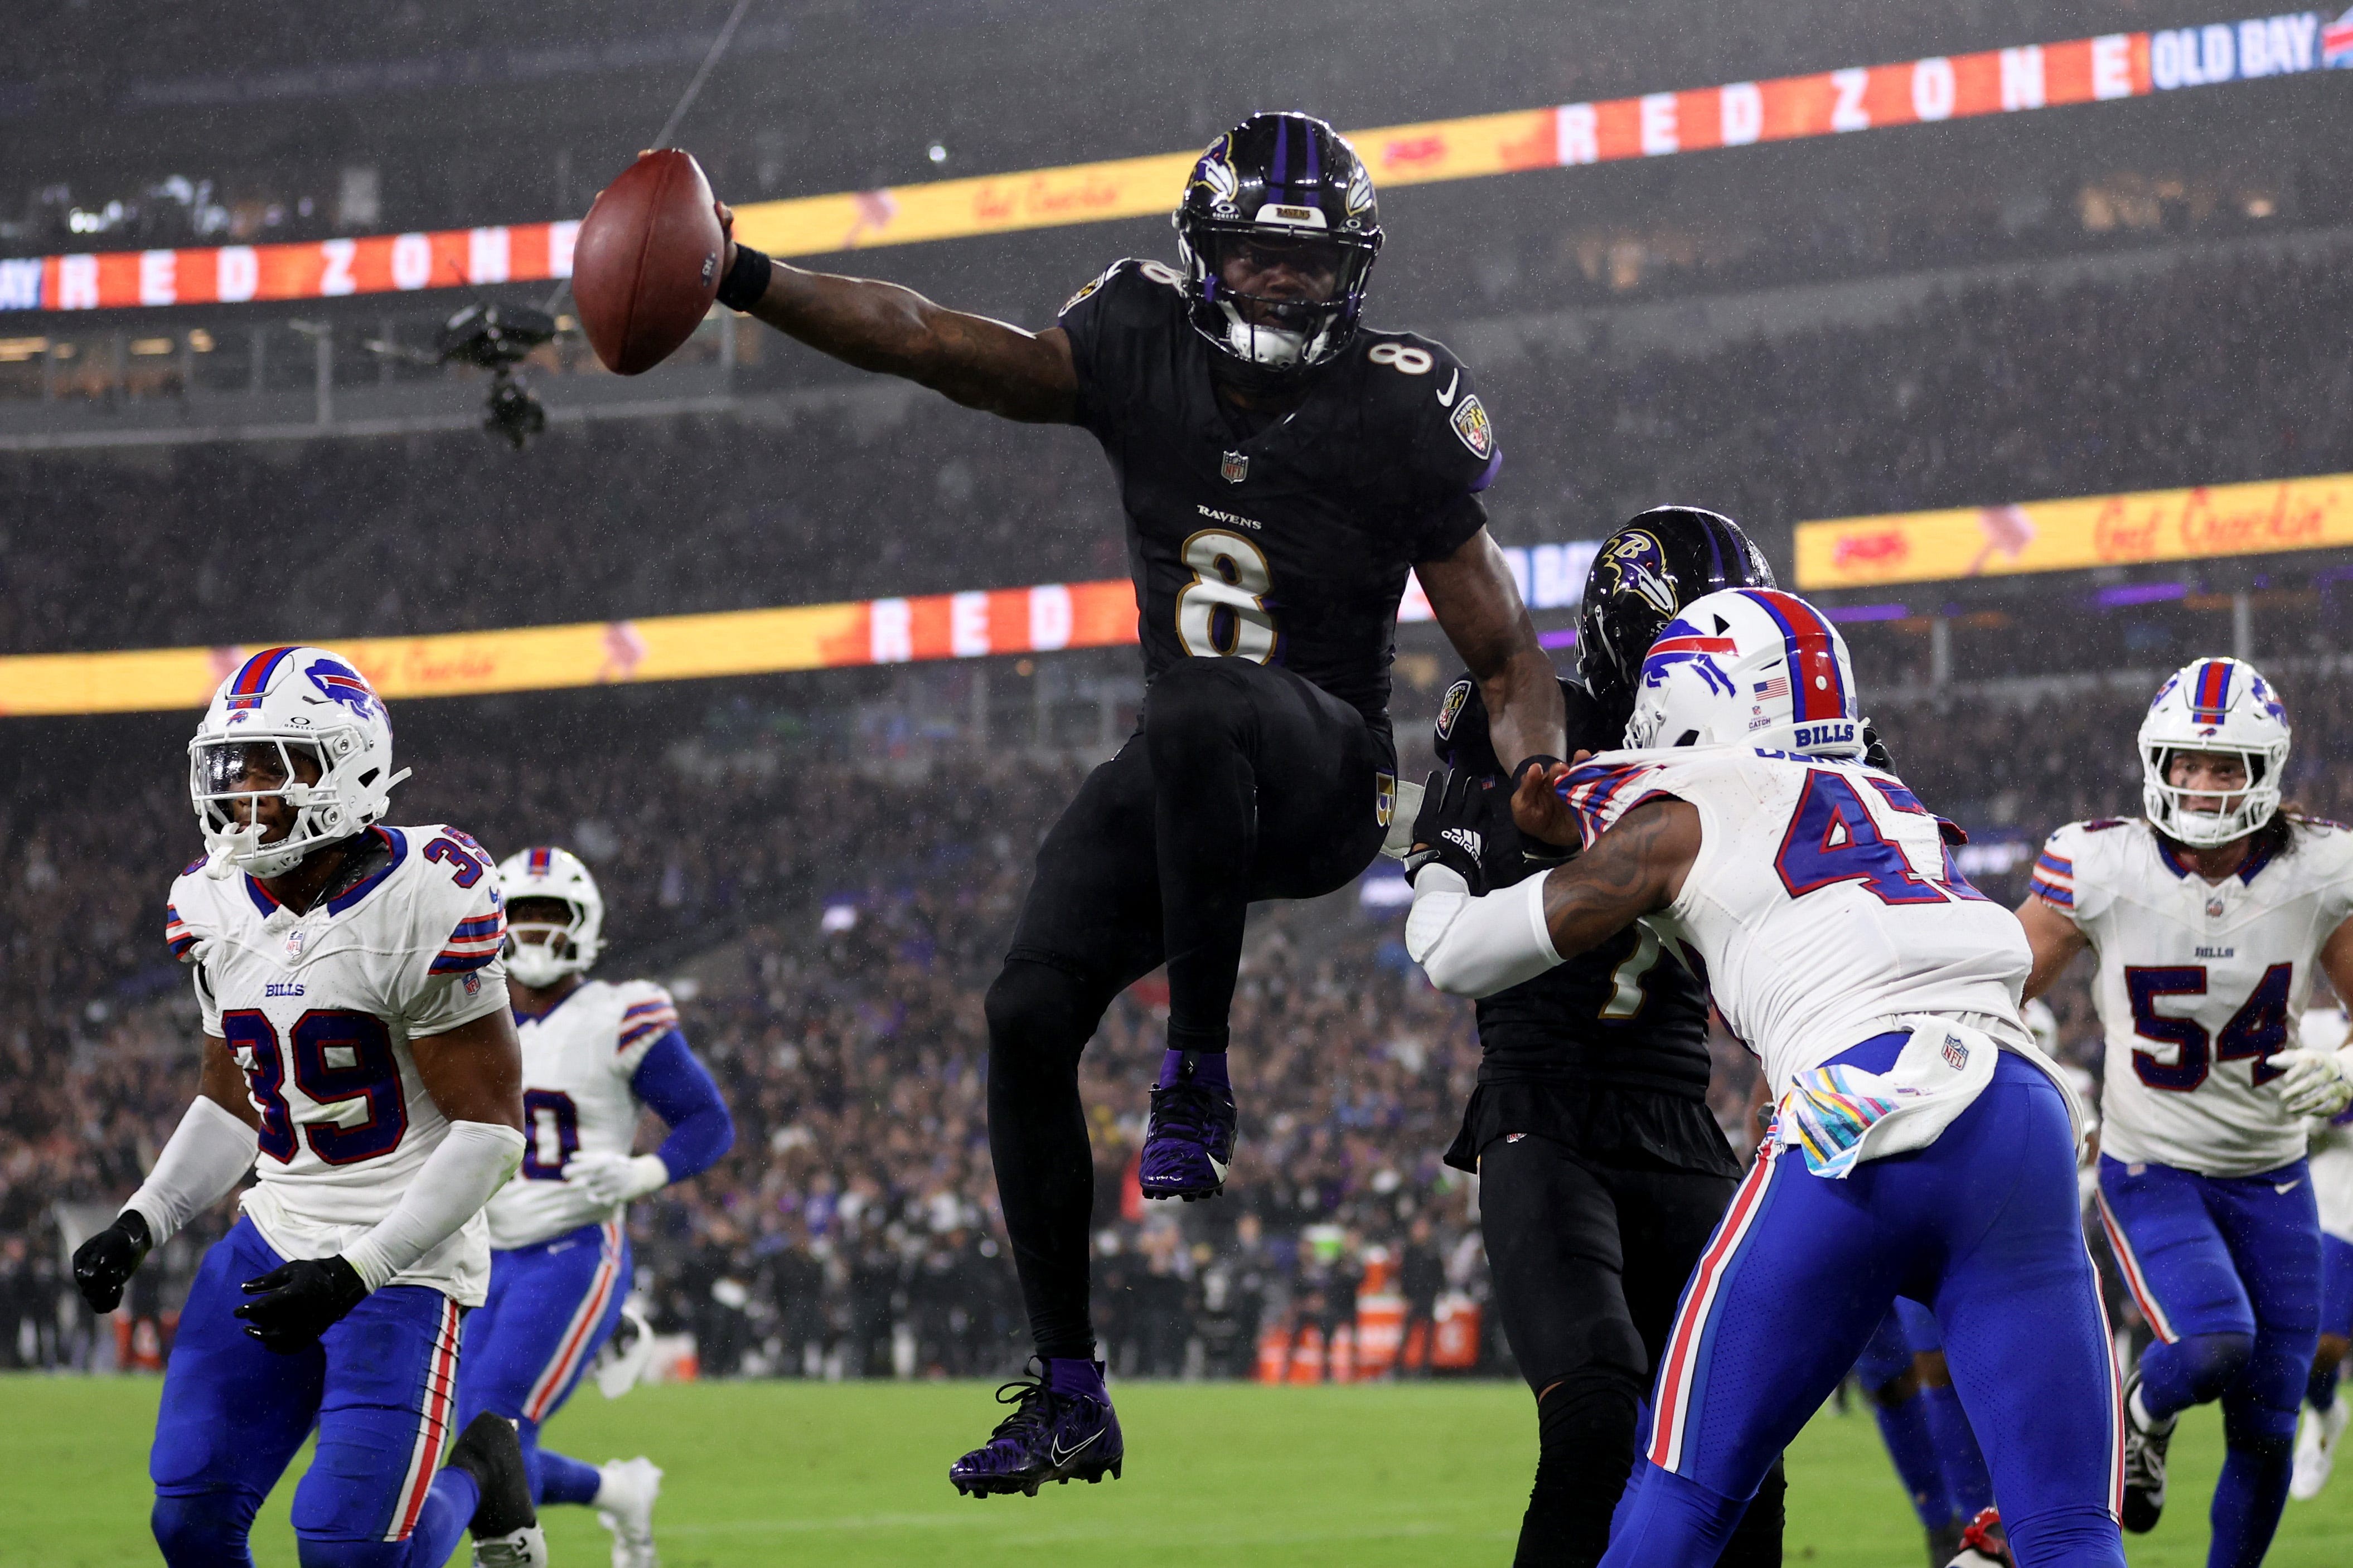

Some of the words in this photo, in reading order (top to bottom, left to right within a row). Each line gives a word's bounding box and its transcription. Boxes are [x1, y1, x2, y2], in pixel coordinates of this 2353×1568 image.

[2152, 23, 2234, 90] OLD
[2239, 11, 2317, 79] BAY
[1276, 207, 1310, 220] RAVENS
[1368, 342, 1434, 375] 8
[1224, 463, 1243, 478] NFL
[1197, 505, 1262, 530] RAVENS
[1175, 528, 1278, 665] 8
[870, 582, 1073, 664] RED
[1749, 717, 1770, 729] CATCH
[1794, 725, 1854, 747] BILLS
[265, 983, 304, 997] BILLS
[2125, 962, 2292, 1091] 54
[1943, 1045, 1962, 1068] NFL
[221, 1008, 409, 1166] 39
